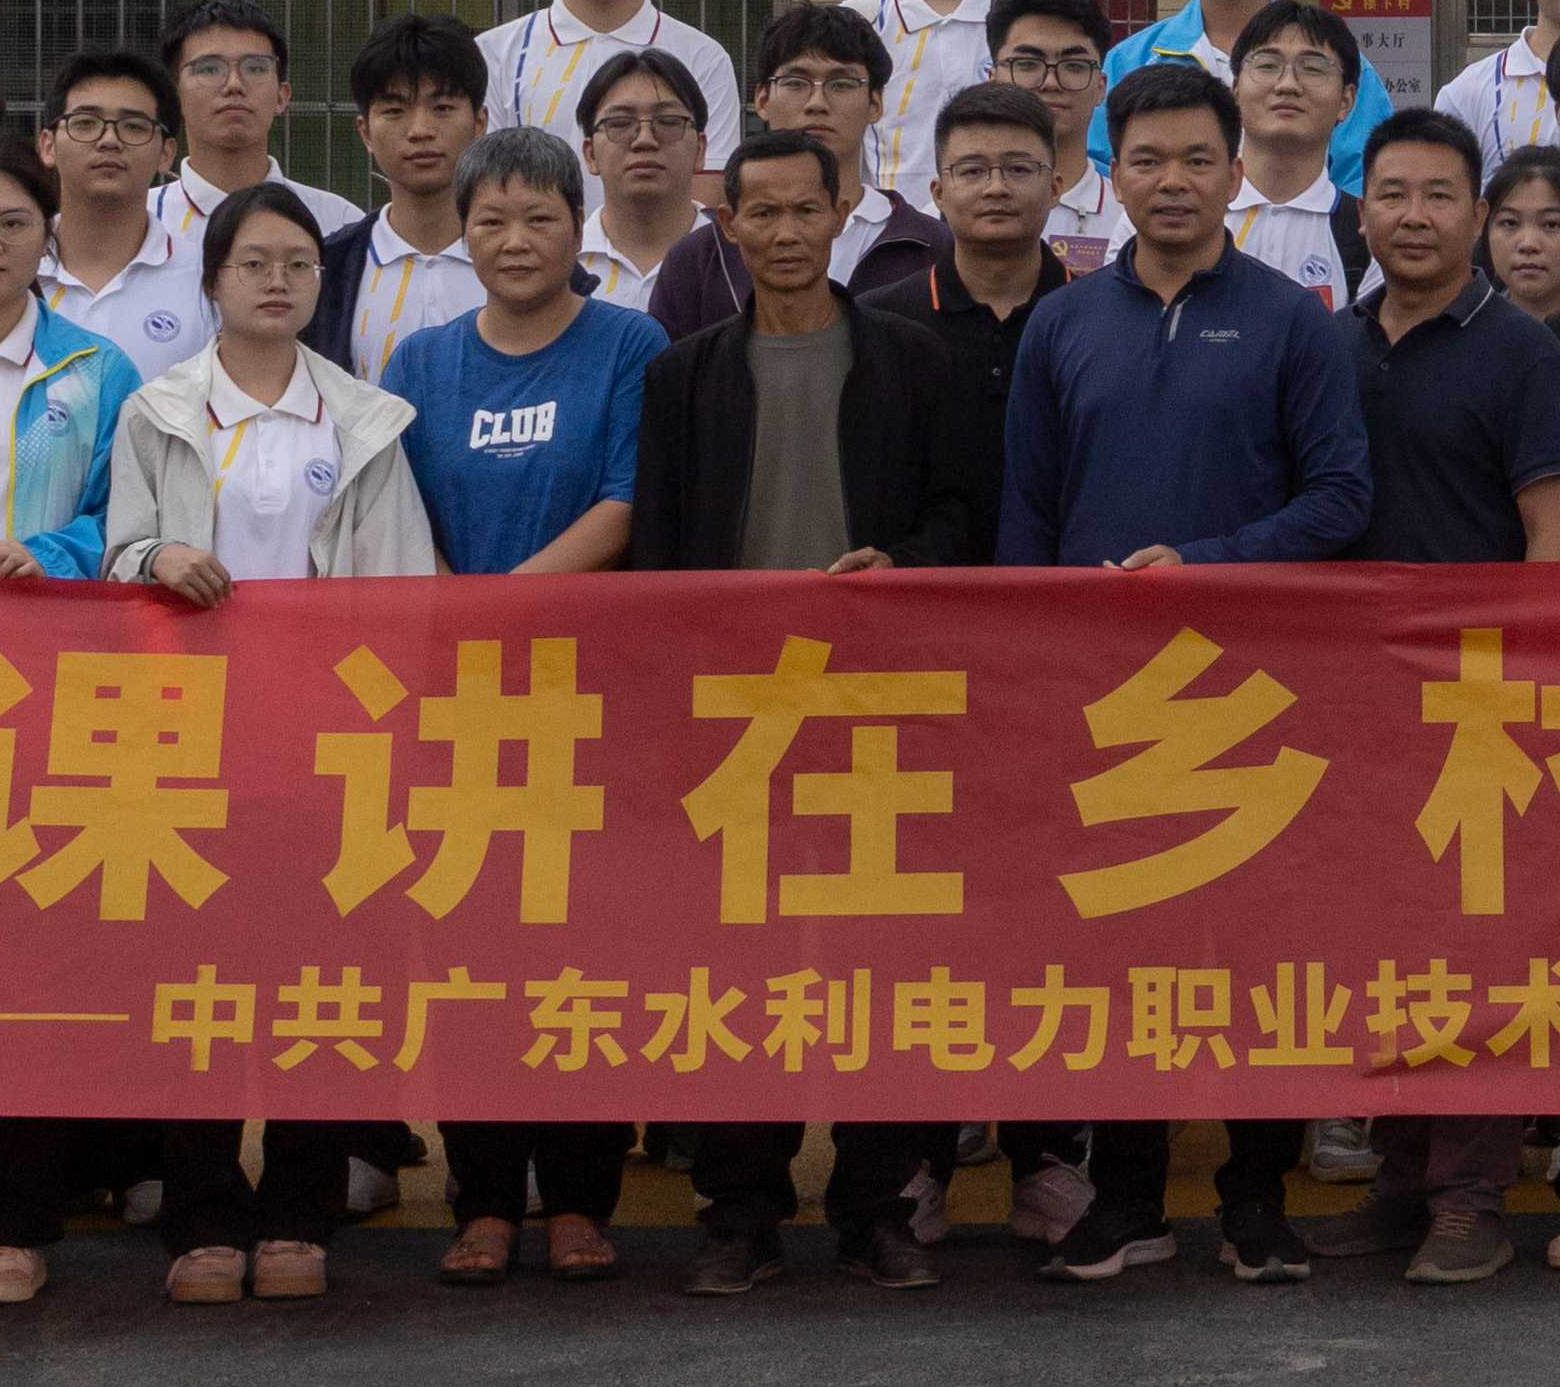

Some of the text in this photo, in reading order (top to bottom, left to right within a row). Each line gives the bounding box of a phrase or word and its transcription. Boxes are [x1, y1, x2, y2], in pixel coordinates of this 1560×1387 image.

[1356, 32, 1407, 49] 事大厅
[469, 400, 558, 449] CLUB
